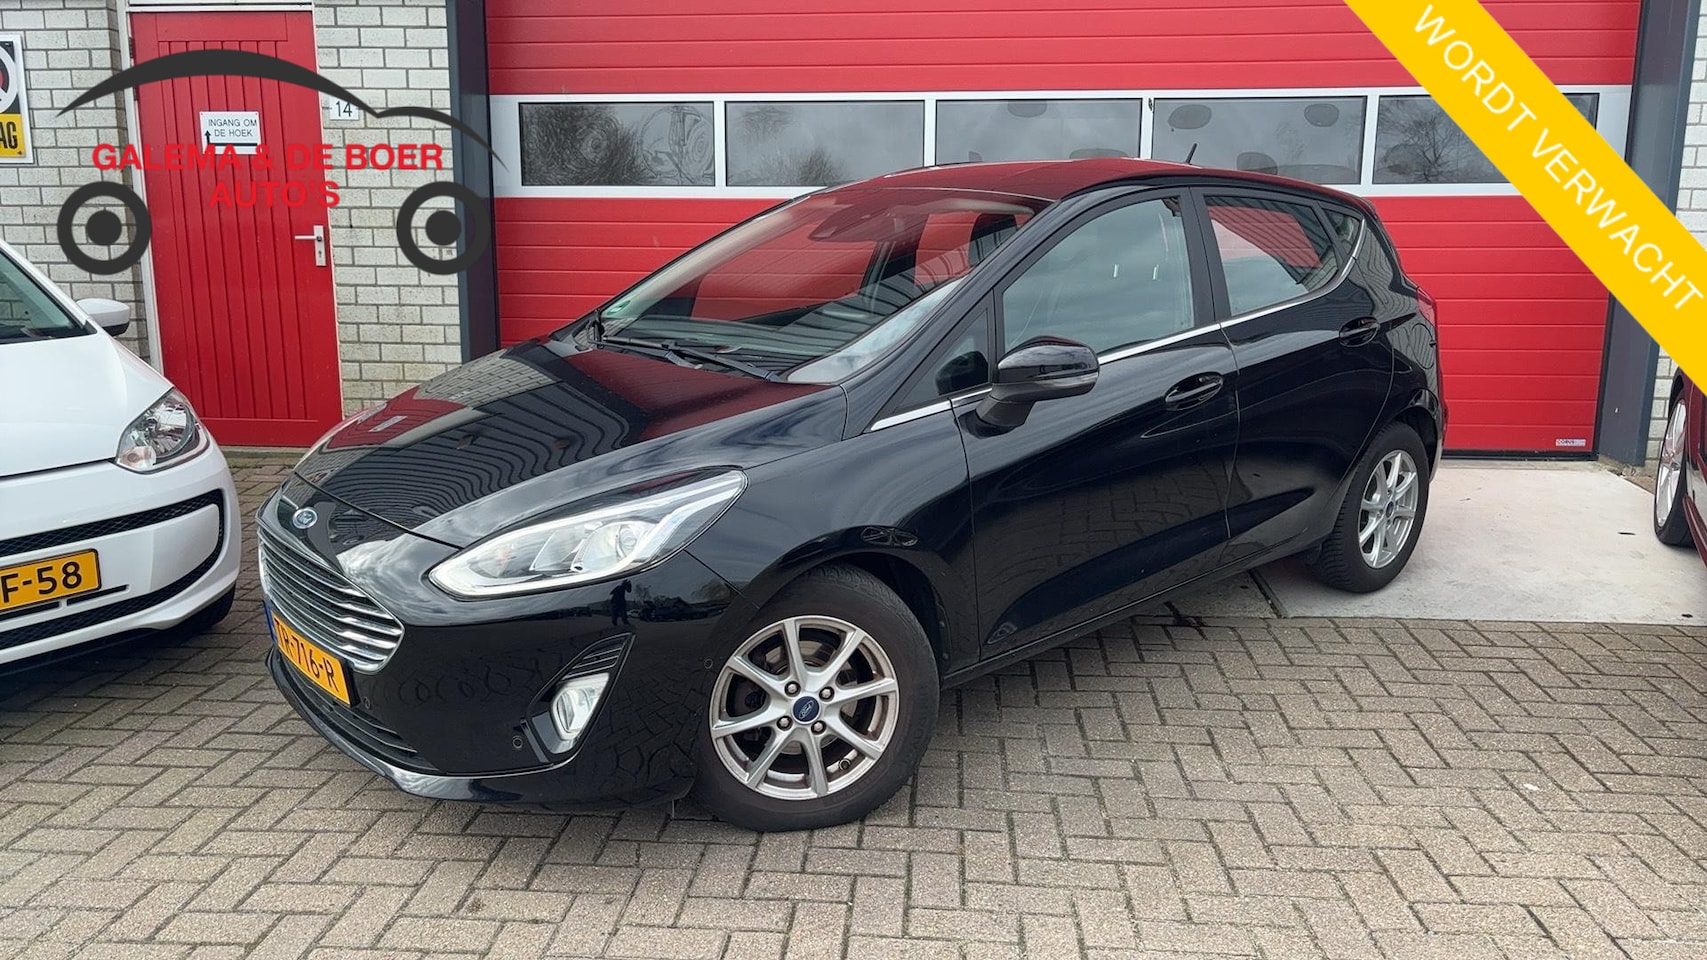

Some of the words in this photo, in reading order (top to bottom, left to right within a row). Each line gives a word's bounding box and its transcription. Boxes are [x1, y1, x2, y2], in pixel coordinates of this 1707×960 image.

[336, 100, 353, 117] 14
[208, 118, 241, 127] INGANG
[243, 118, 257, 127] OM
[214, 129, 226, 137] DE
[228, 128, 253, 137] HOEK
[1, 561, 82, 603] F-58
[273, 617, 340, 693] TR-716-R
